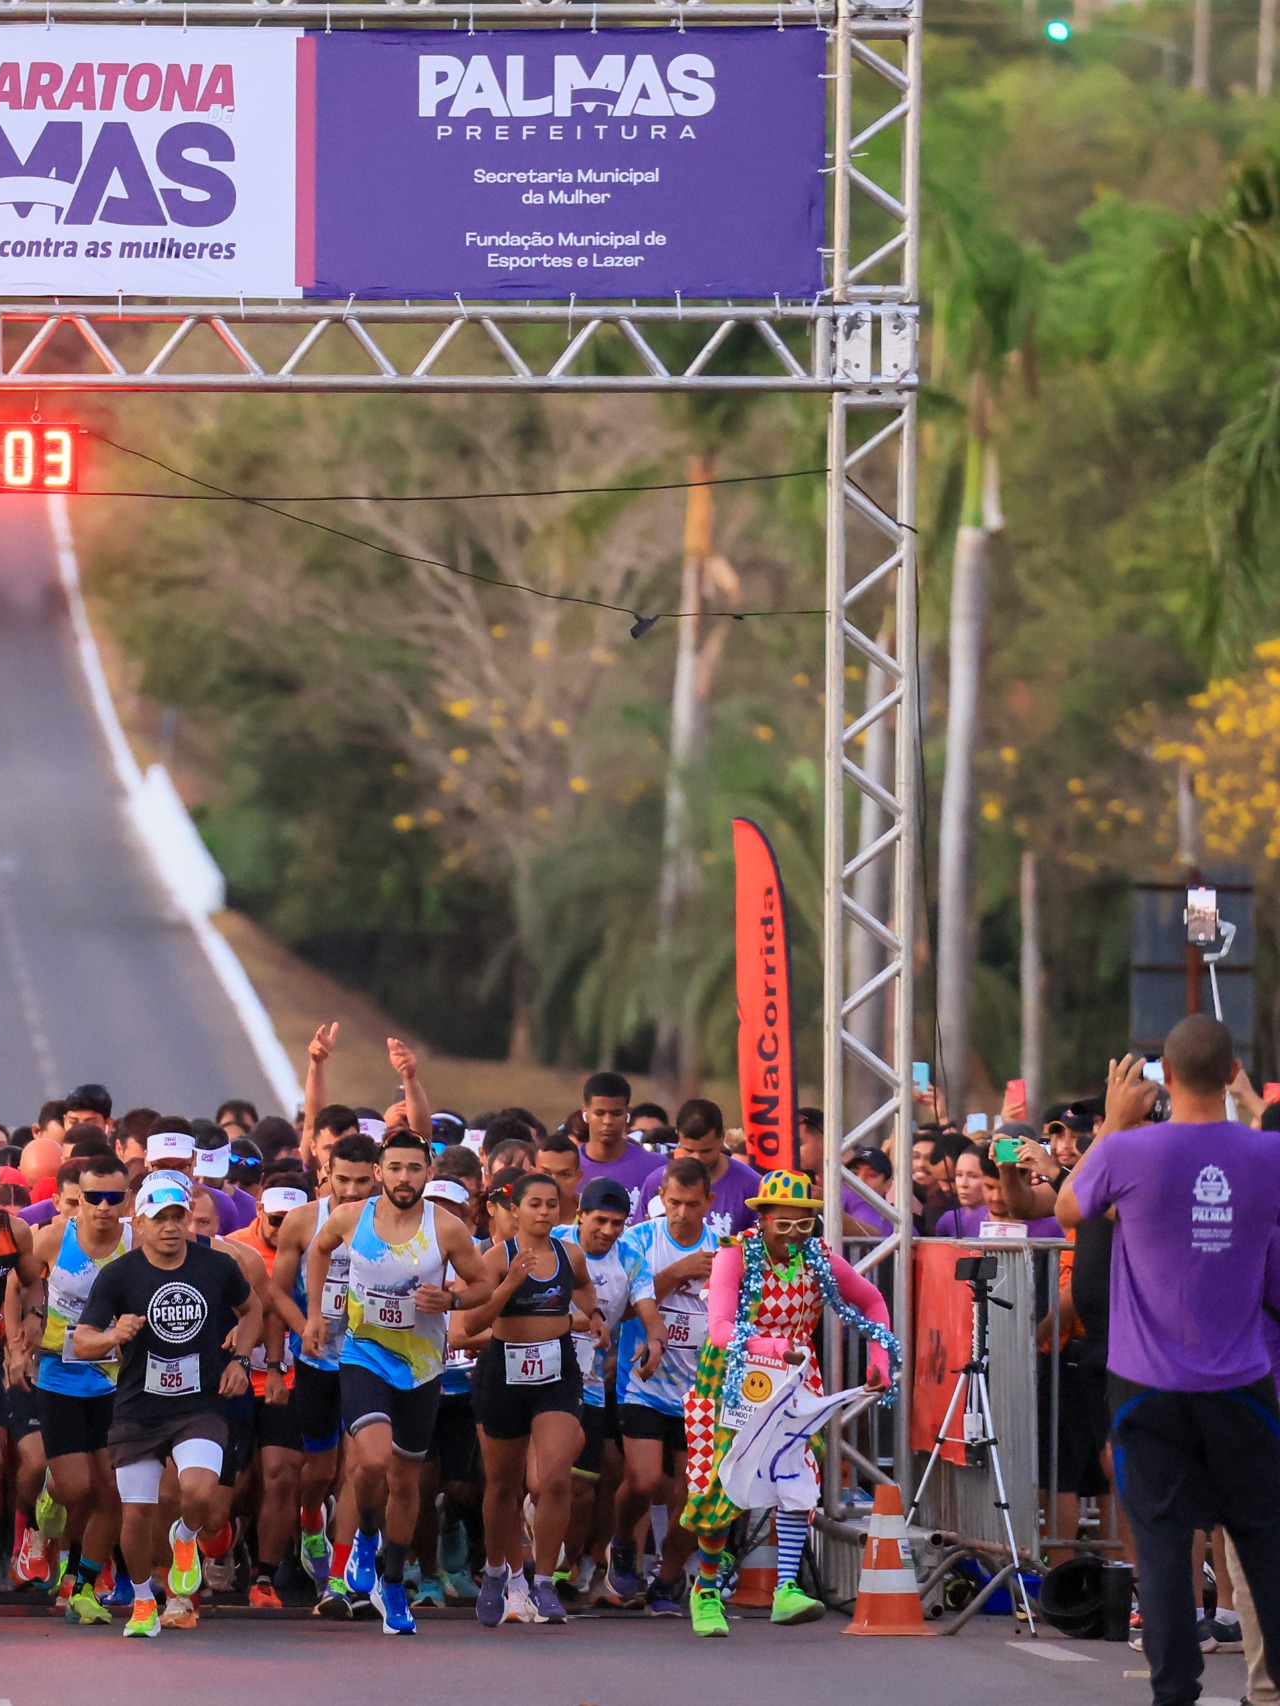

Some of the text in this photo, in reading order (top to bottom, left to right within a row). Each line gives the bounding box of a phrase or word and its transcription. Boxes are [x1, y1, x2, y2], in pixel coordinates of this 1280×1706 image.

[418, 54, 716, 117] PALMAS
[437, 125, 696, 140] PREFEITURA
[473, 168, 660, 186] Secretaria Municipal
[522, 190, 611, 205] da Mulher
[0, 238, 77, 258] contra
[85, 241, 112, 258] as
[119, 238, 237, 260] mulheres
[465, 231, 667, 251] Fundação Municipal de
[487, 253, 645, 271] Esportes e Lazer
[152, 1304, 203, 1323] PEREIRA
[379, 1308, 403, 1324] 033
[668, 1323, 690, 1342] 055
[521, 1359, 544, 1376] 471
[160, 1372, 183, 1388] 525
[728, 1409, 748, 1420] SENDO
